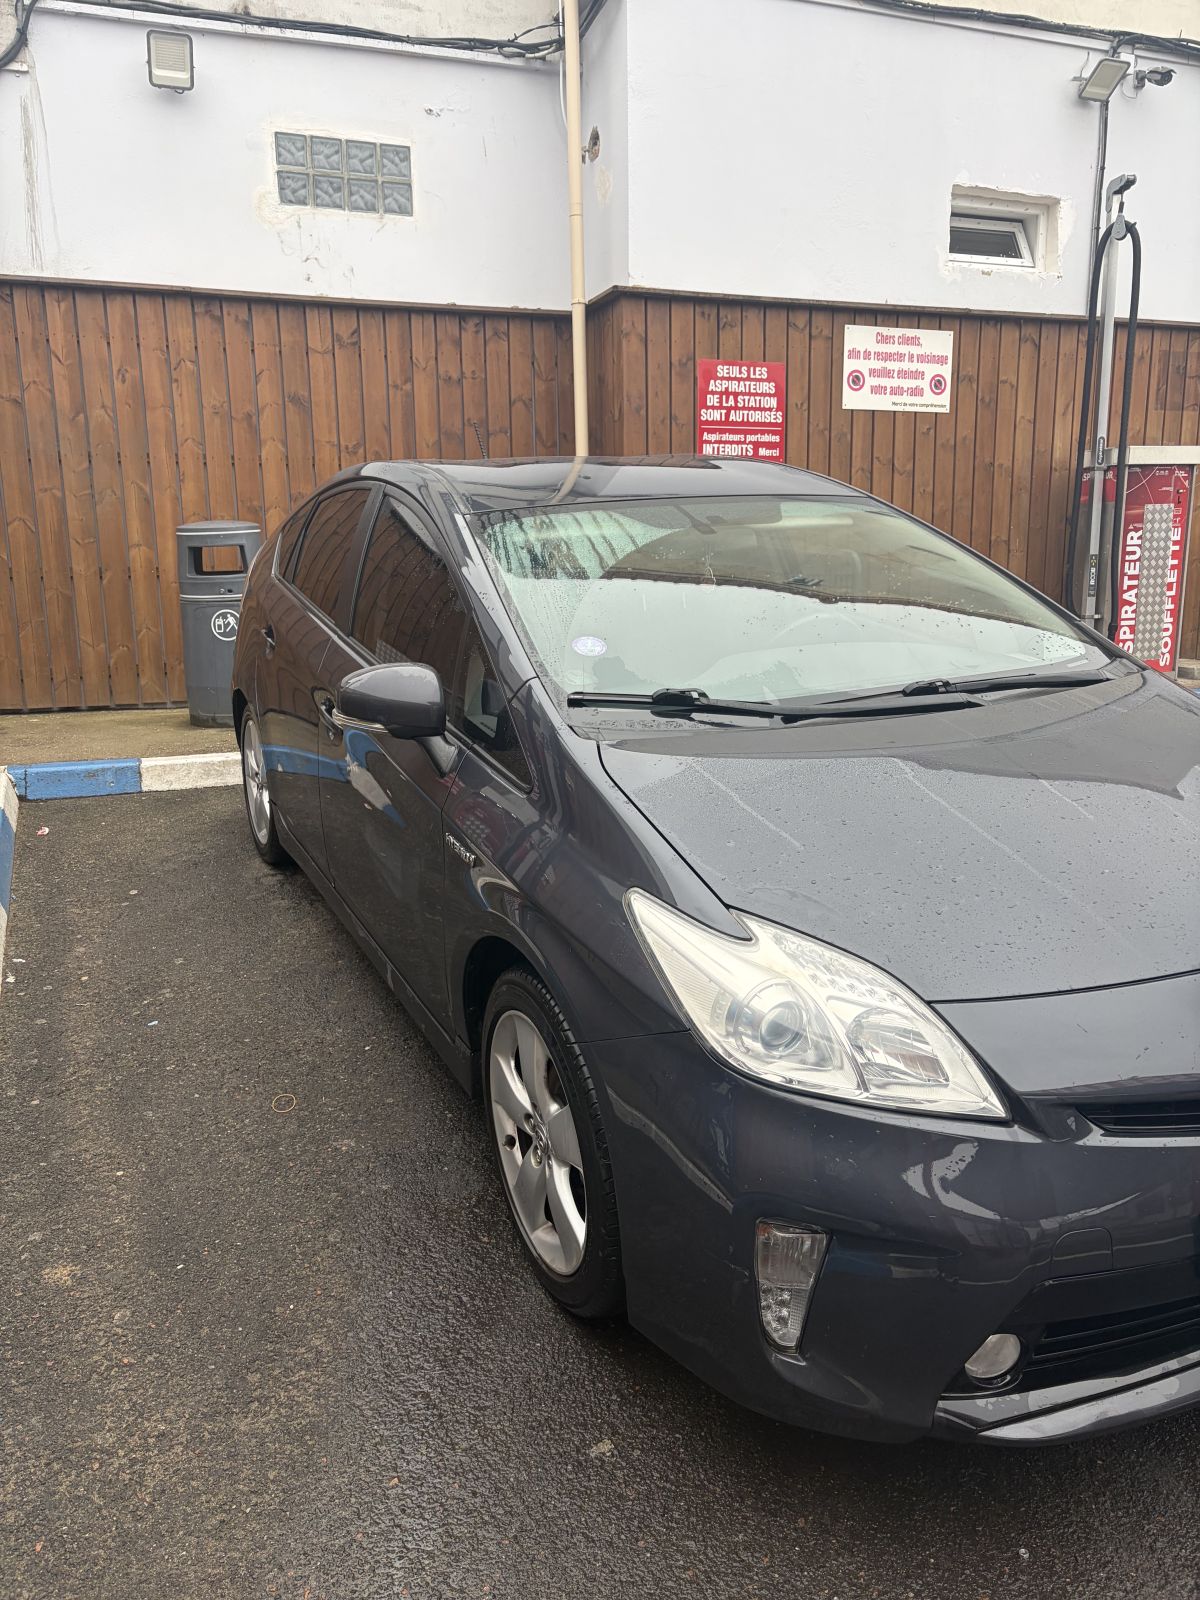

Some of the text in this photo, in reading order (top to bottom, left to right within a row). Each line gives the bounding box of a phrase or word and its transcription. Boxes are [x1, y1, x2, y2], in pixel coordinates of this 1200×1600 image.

[875, 332, 923, 348] Chers clients,
[847, 347, 949, 366] afin de respecter le voisinage
[717, 365, 768, 379] SEULS LES
[868, 366, 926, 380] veuillez éteindre
[709, 379, 776, 394] ASPIRATEURS
[870, 384, 925, 397] votre auto-radio
[706, 394, 778, 409] DE LA STATION
[700, 409, 783, 423] SONT AUTORISÉS
[702, 432, 780, 443] Aspirateurs portables
[702, 443, 780, 457] INTERDITS Merci
[1119, 530, 1144, 656] SPIRATEUR
[1159, 527, 1182, 667] SOUFFLETTE
